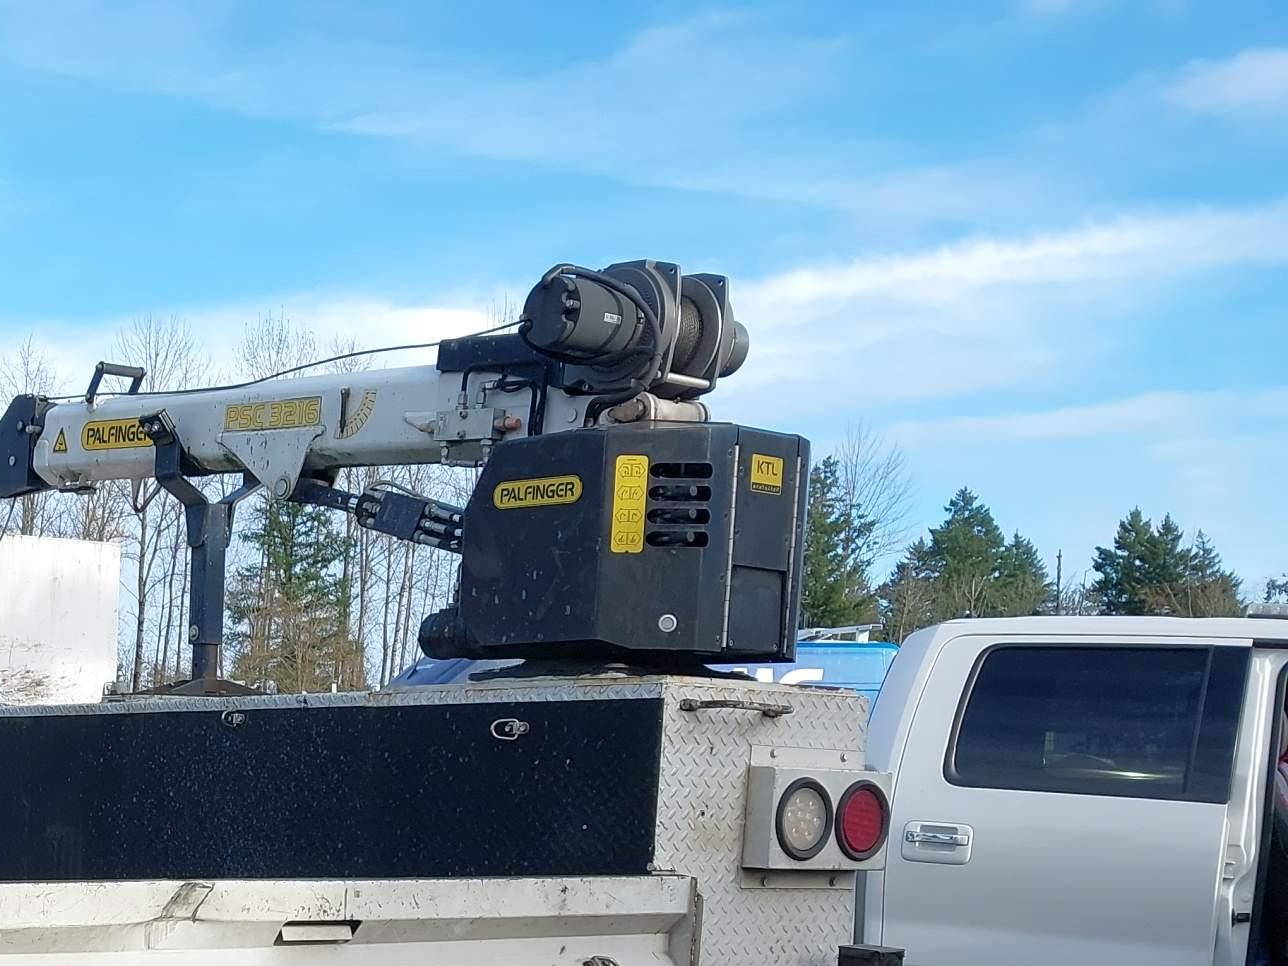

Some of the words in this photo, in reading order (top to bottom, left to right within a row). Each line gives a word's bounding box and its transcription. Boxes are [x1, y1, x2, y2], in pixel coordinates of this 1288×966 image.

[226, 404, 265, 429] PSC
[269, 399, 320, 427] 3216
[757, 459, 778, 476] KTL
[499, 481, 576, 504] PALFINGER
